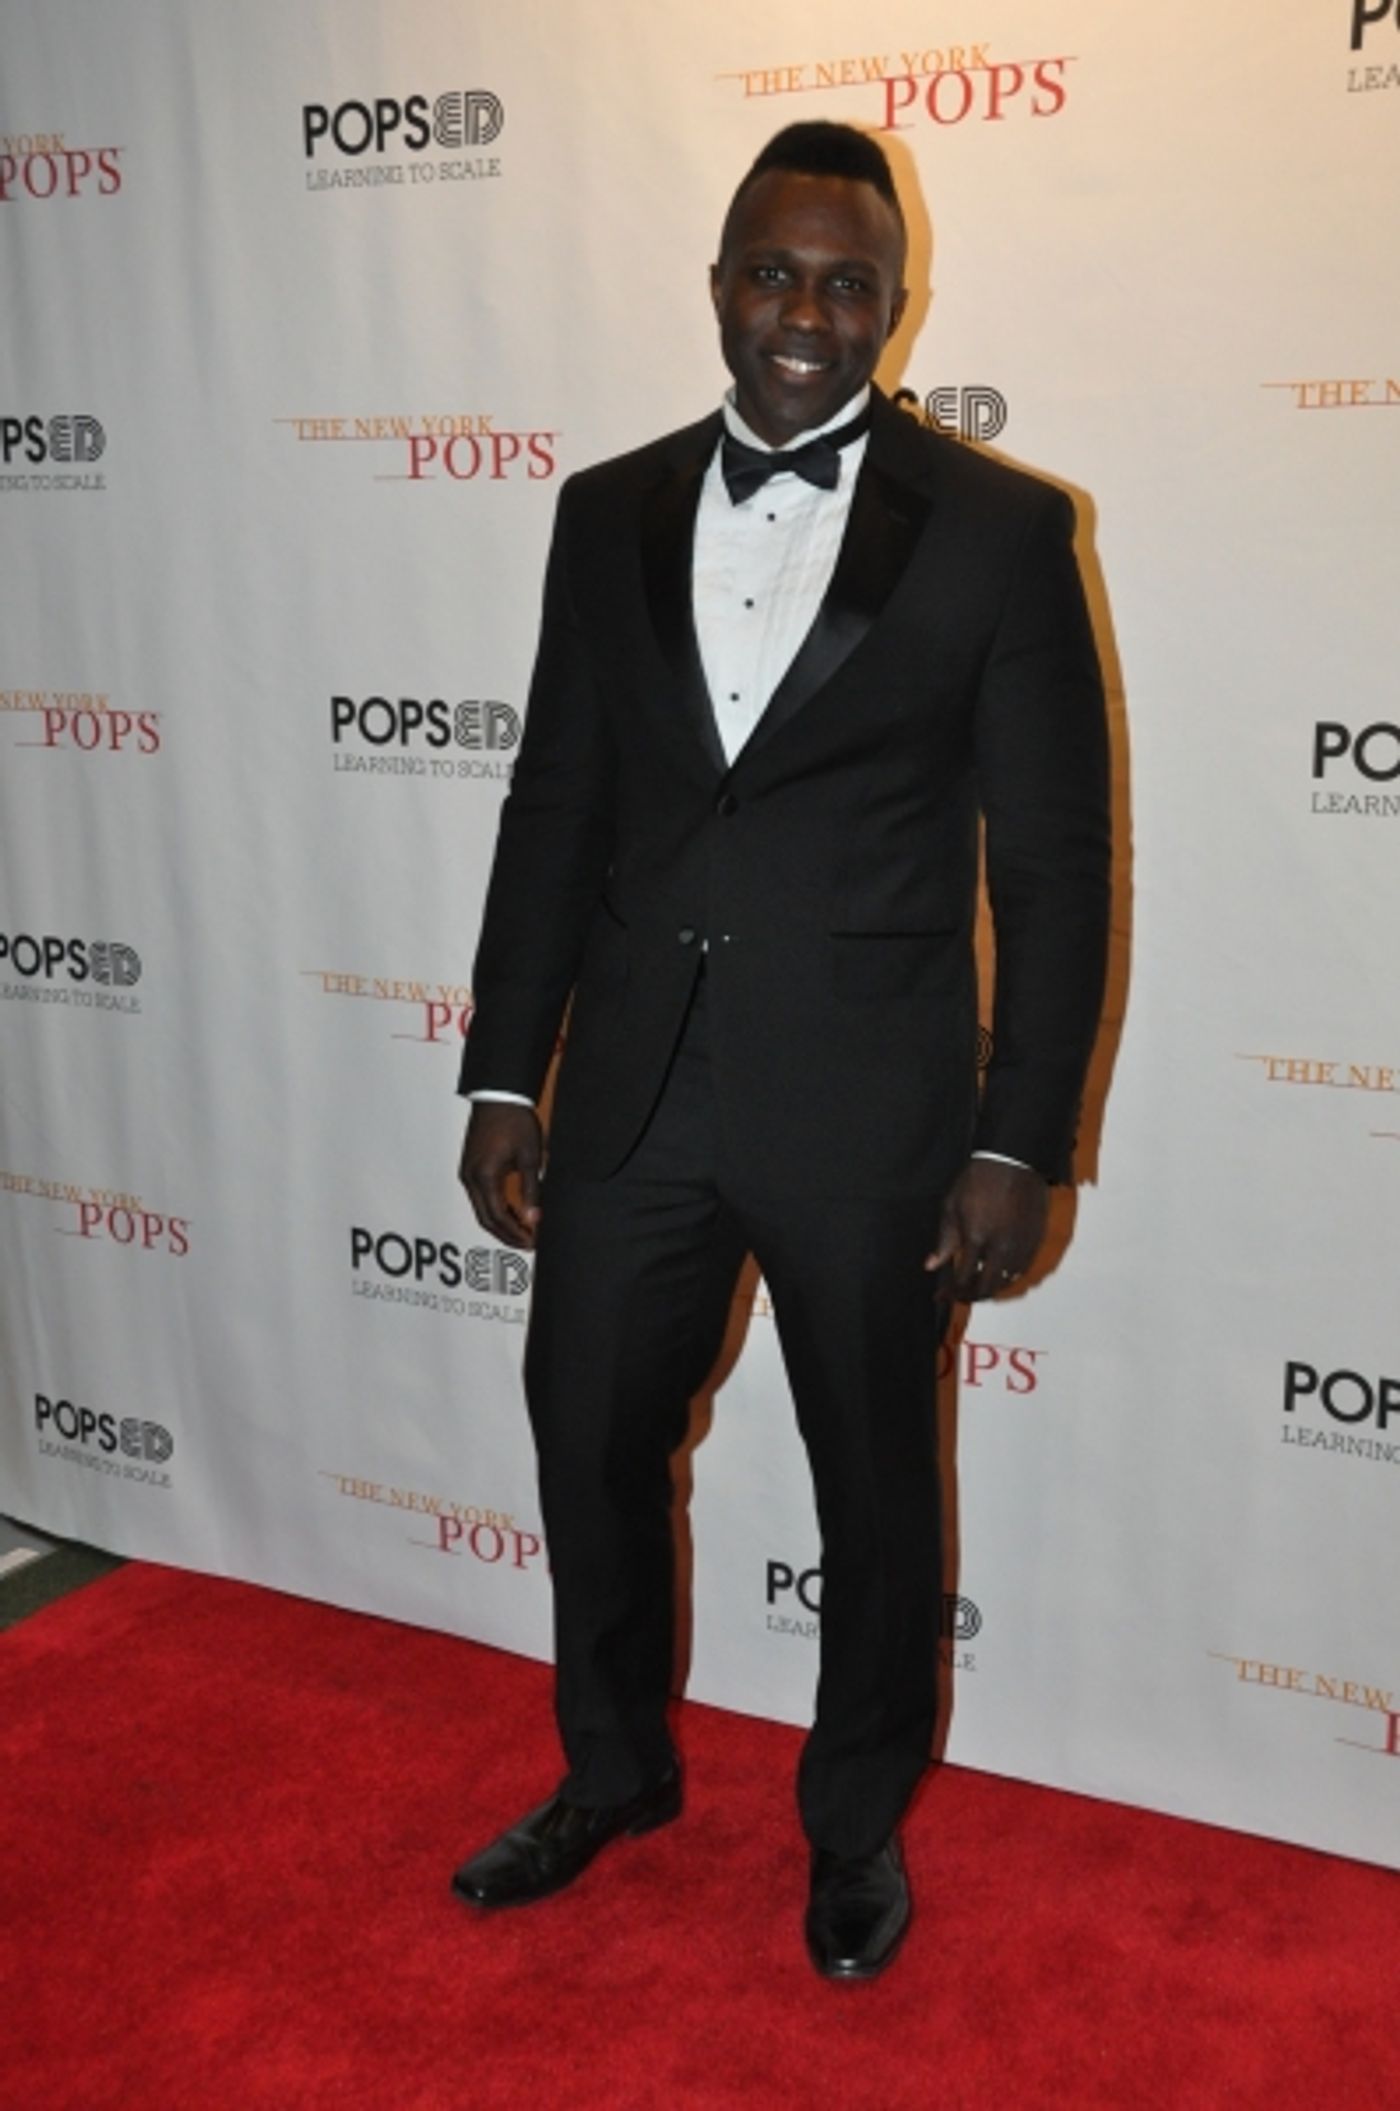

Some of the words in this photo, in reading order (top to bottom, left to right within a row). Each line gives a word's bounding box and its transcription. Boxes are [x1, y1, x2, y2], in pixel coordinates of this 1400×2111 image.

[738, 66, 805, 97] THE
[815, 56, 889, 89] NEW
[900, 43, 992, 76] YORK
[879, 59, 1067, 131] POPS
[0, 148, 122, 200] POPS
[306, 164, 404, 191] LEARNING
[408, 162, 434, 184] TO
[439, 159, 502, 181] SCALE
[1290, 380, 1375, 409] THE
[293, 418, 348, 440] THE
[354, 416, 413, 439] NEW
[422, 415, 494, 438] YORK
[407, 432, 556, 480] POPS
[53, 692, 109, 712] YORK
[43, 707, 160, 754] POPS
[334, 753, 426, 776] LEARNING
[430, 760, 454, 778] TO
[320, 971, 367, 996] THE
[373, 977, 430, 1001] NEW
[1263, 1055, 1341, 1085] THE
[79, 1202, 190, 1257] POPS
[352, 1279, 438, 1310] LEARNING
[468, 1301, 526, 1324] SCALE
[336, 1475, 383, 1502] THE
[389, 1487, 444, 1515] NEW
[451, 1502, 516, 1531] YORK
[437, 1514, 549, 1570] POP
[1232, 1659, 1308, 1691] THE
[1315, 1674, 1394, 1713] NEW
